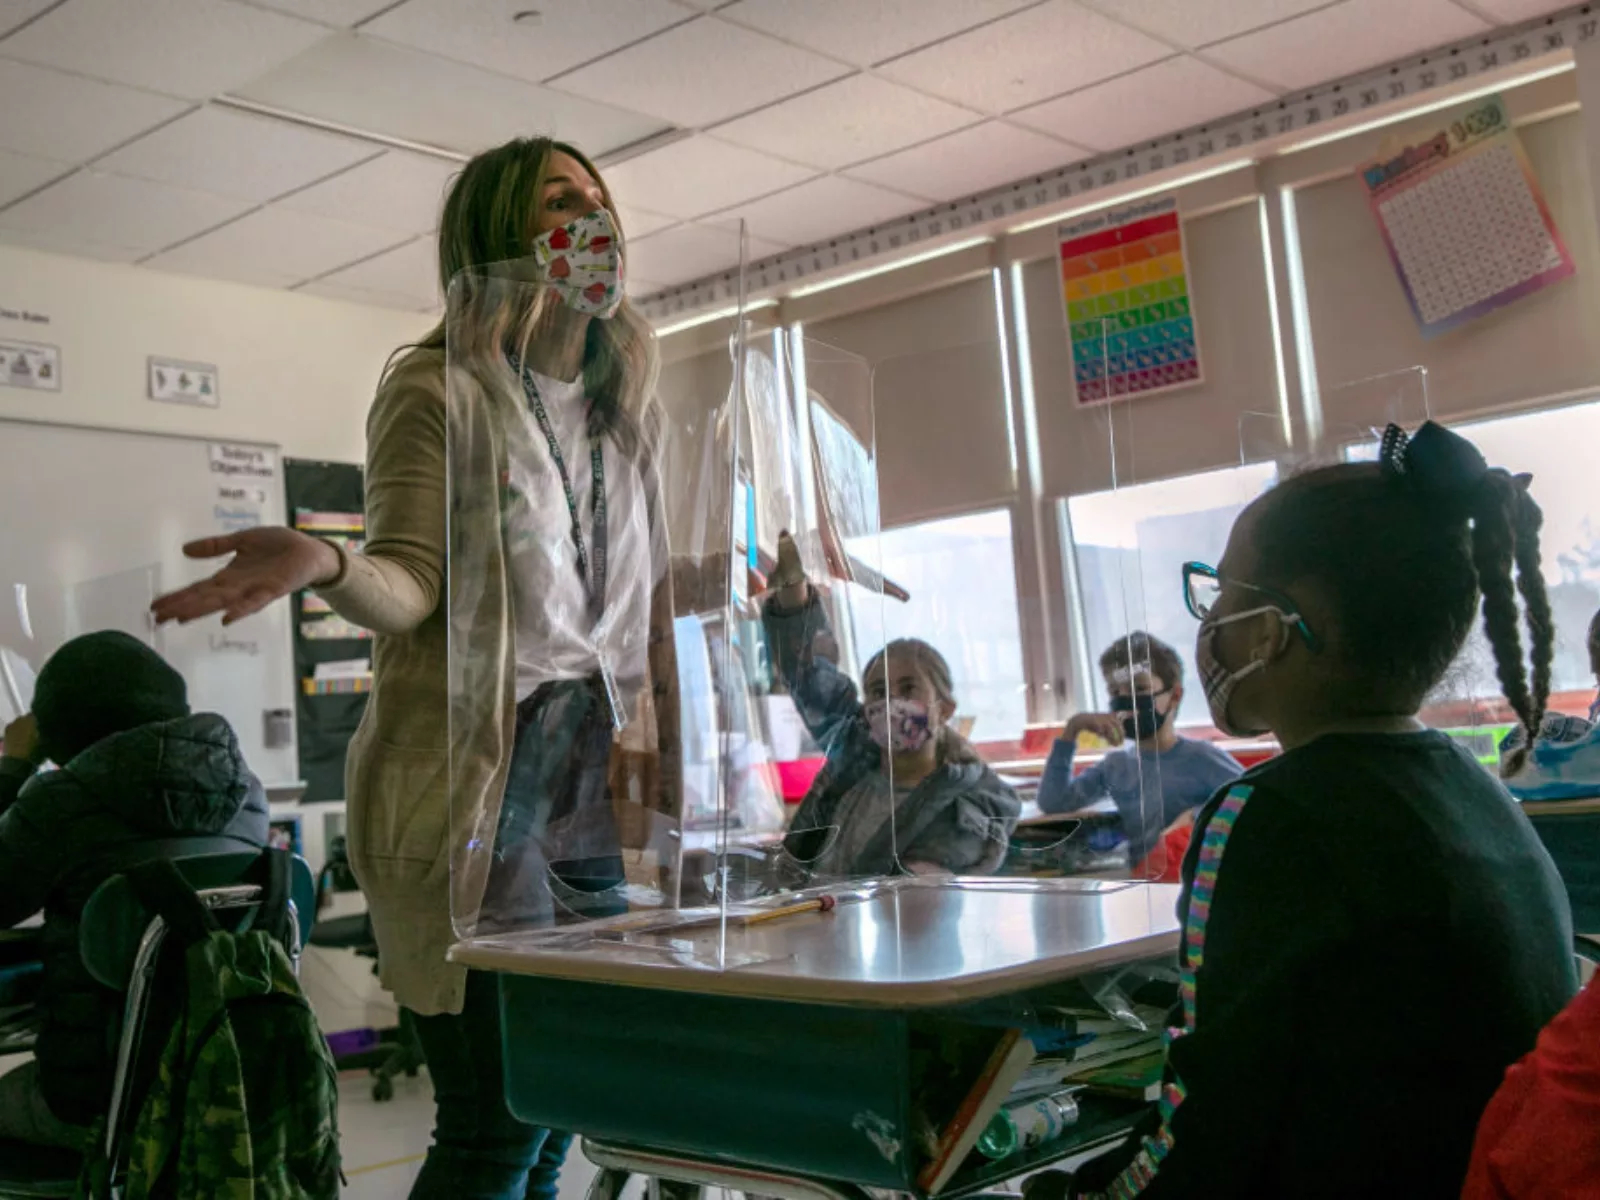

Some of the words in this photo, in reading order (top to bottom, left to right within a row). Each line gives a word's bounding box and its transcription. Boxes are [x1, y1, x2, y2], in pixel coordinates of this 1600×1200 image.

[1332, 97, 1349, 116] 29
[1360, 88, 1378, 108] 30
[1387, 80, 1405, 99] 31
[1418, 69, 1437, 89] 32
[1448, 61, 1467, 80] 33
[1479, 51, 1498, 71] 34
[1510, 41, 1531, 61] 35
[1543, 32, 1563, 52] 36
[1578, 20, 1596, 40] 37
